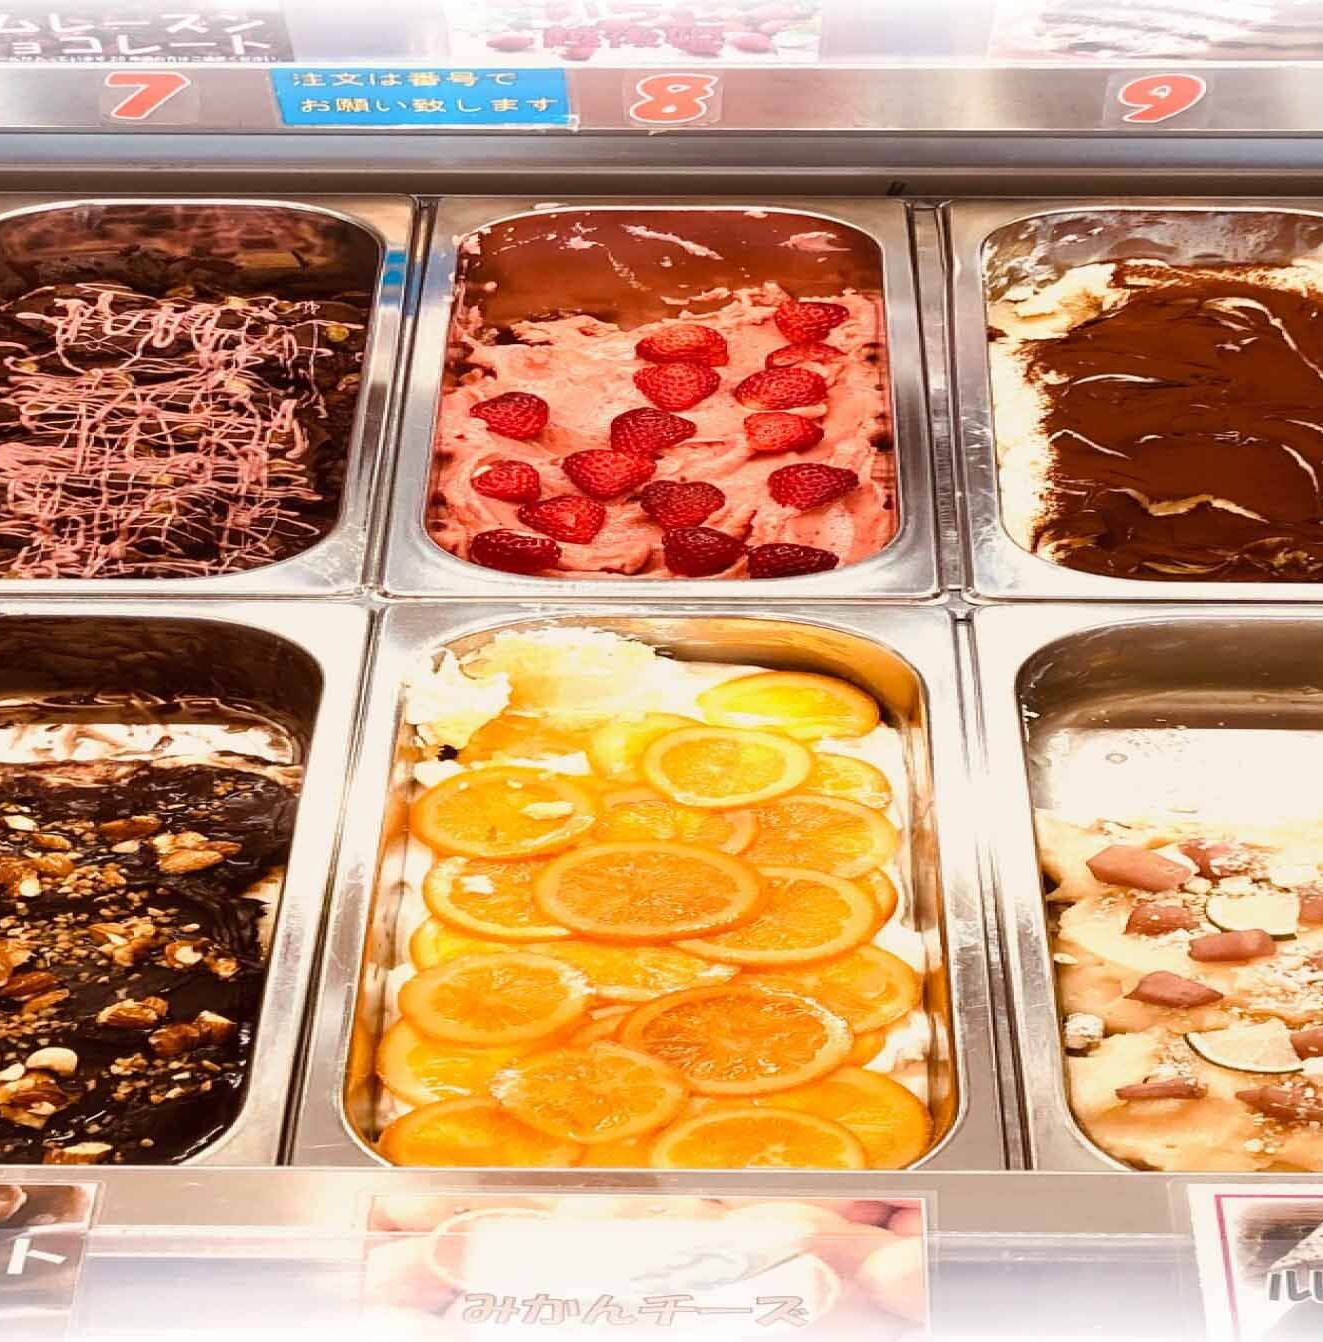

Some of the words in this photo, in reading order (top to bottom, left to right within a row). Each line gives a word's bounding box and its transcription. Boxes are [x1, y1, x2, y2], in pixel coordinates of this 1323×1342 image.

[104, 71, 191, 120] 7
[292, 71, 519, 88] 注文は番号で
[628, 72, 720, 124] 8
[1117, 72, 1207, 124] 9
[299, 95, 559, 114] お願い致します
[460, 1291, 811, 1329] みかんチーズ
